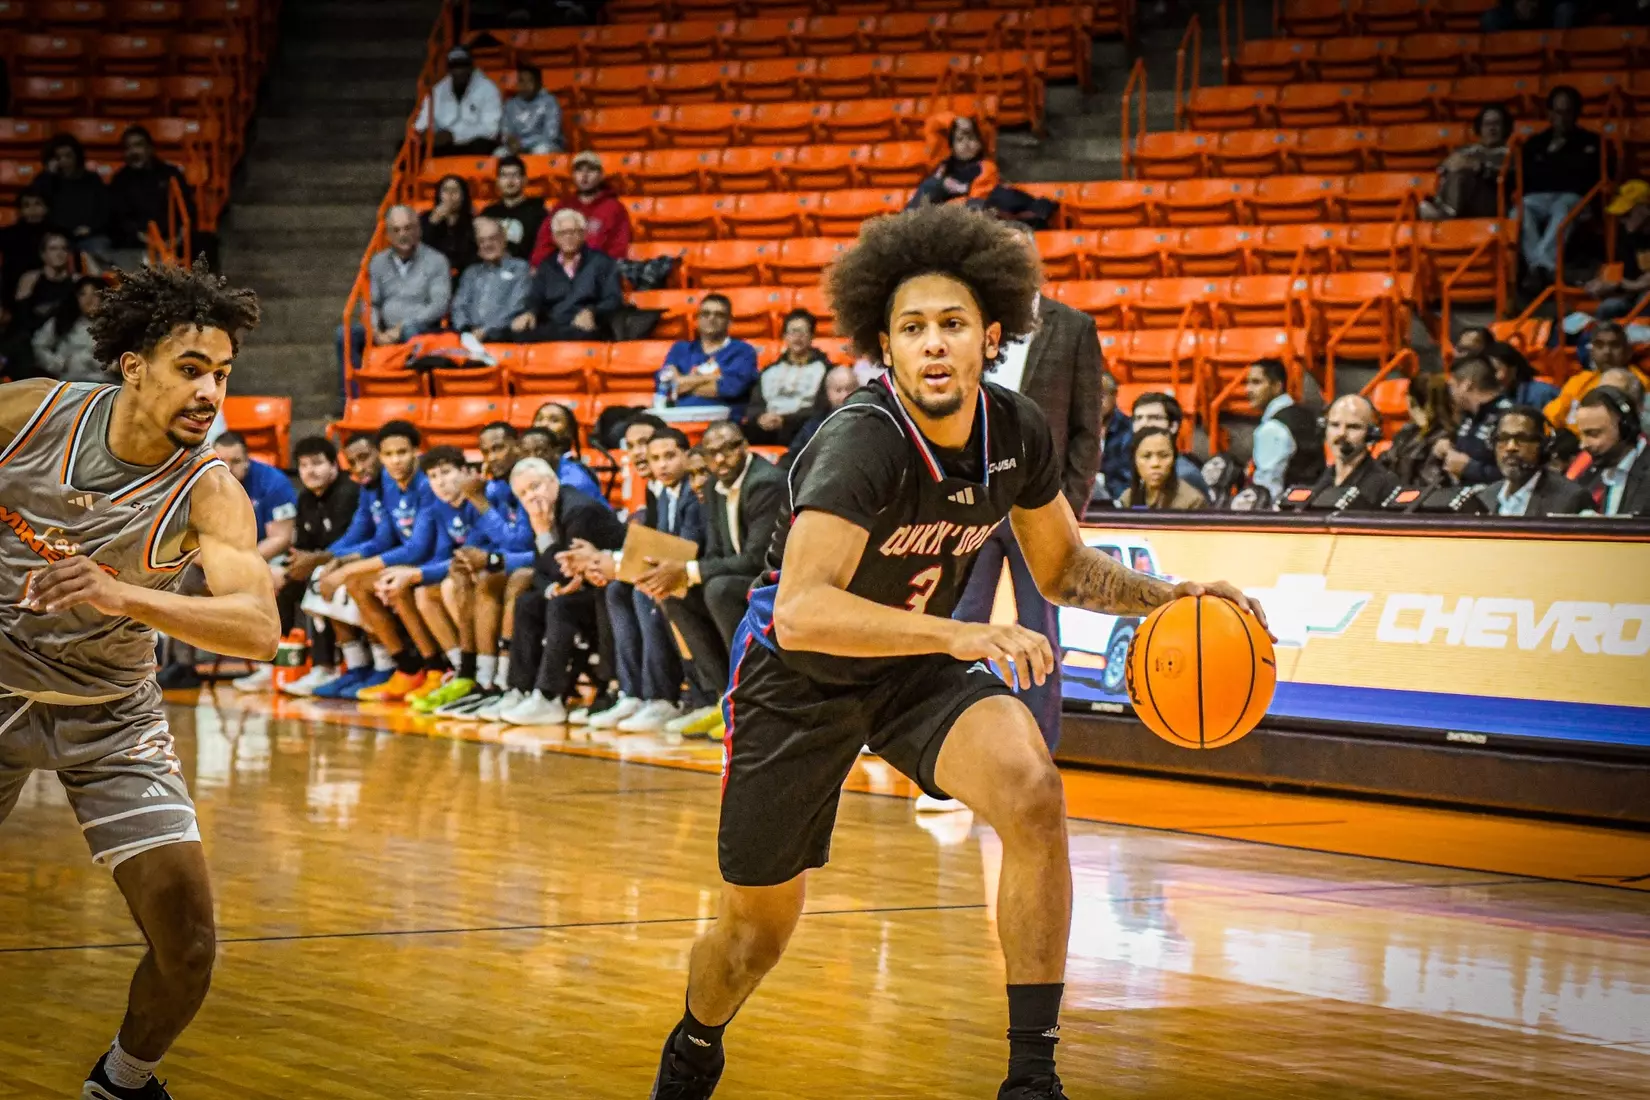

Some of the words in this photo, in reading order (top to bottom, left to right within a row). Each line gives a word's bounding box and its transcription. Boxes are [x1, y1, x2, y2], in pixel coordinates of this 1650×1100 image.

[988, 457, 1017, 474] C-USA
[905, 563, 943, 614] 3
[1376, 593, 1650, 656] CHEVRO
